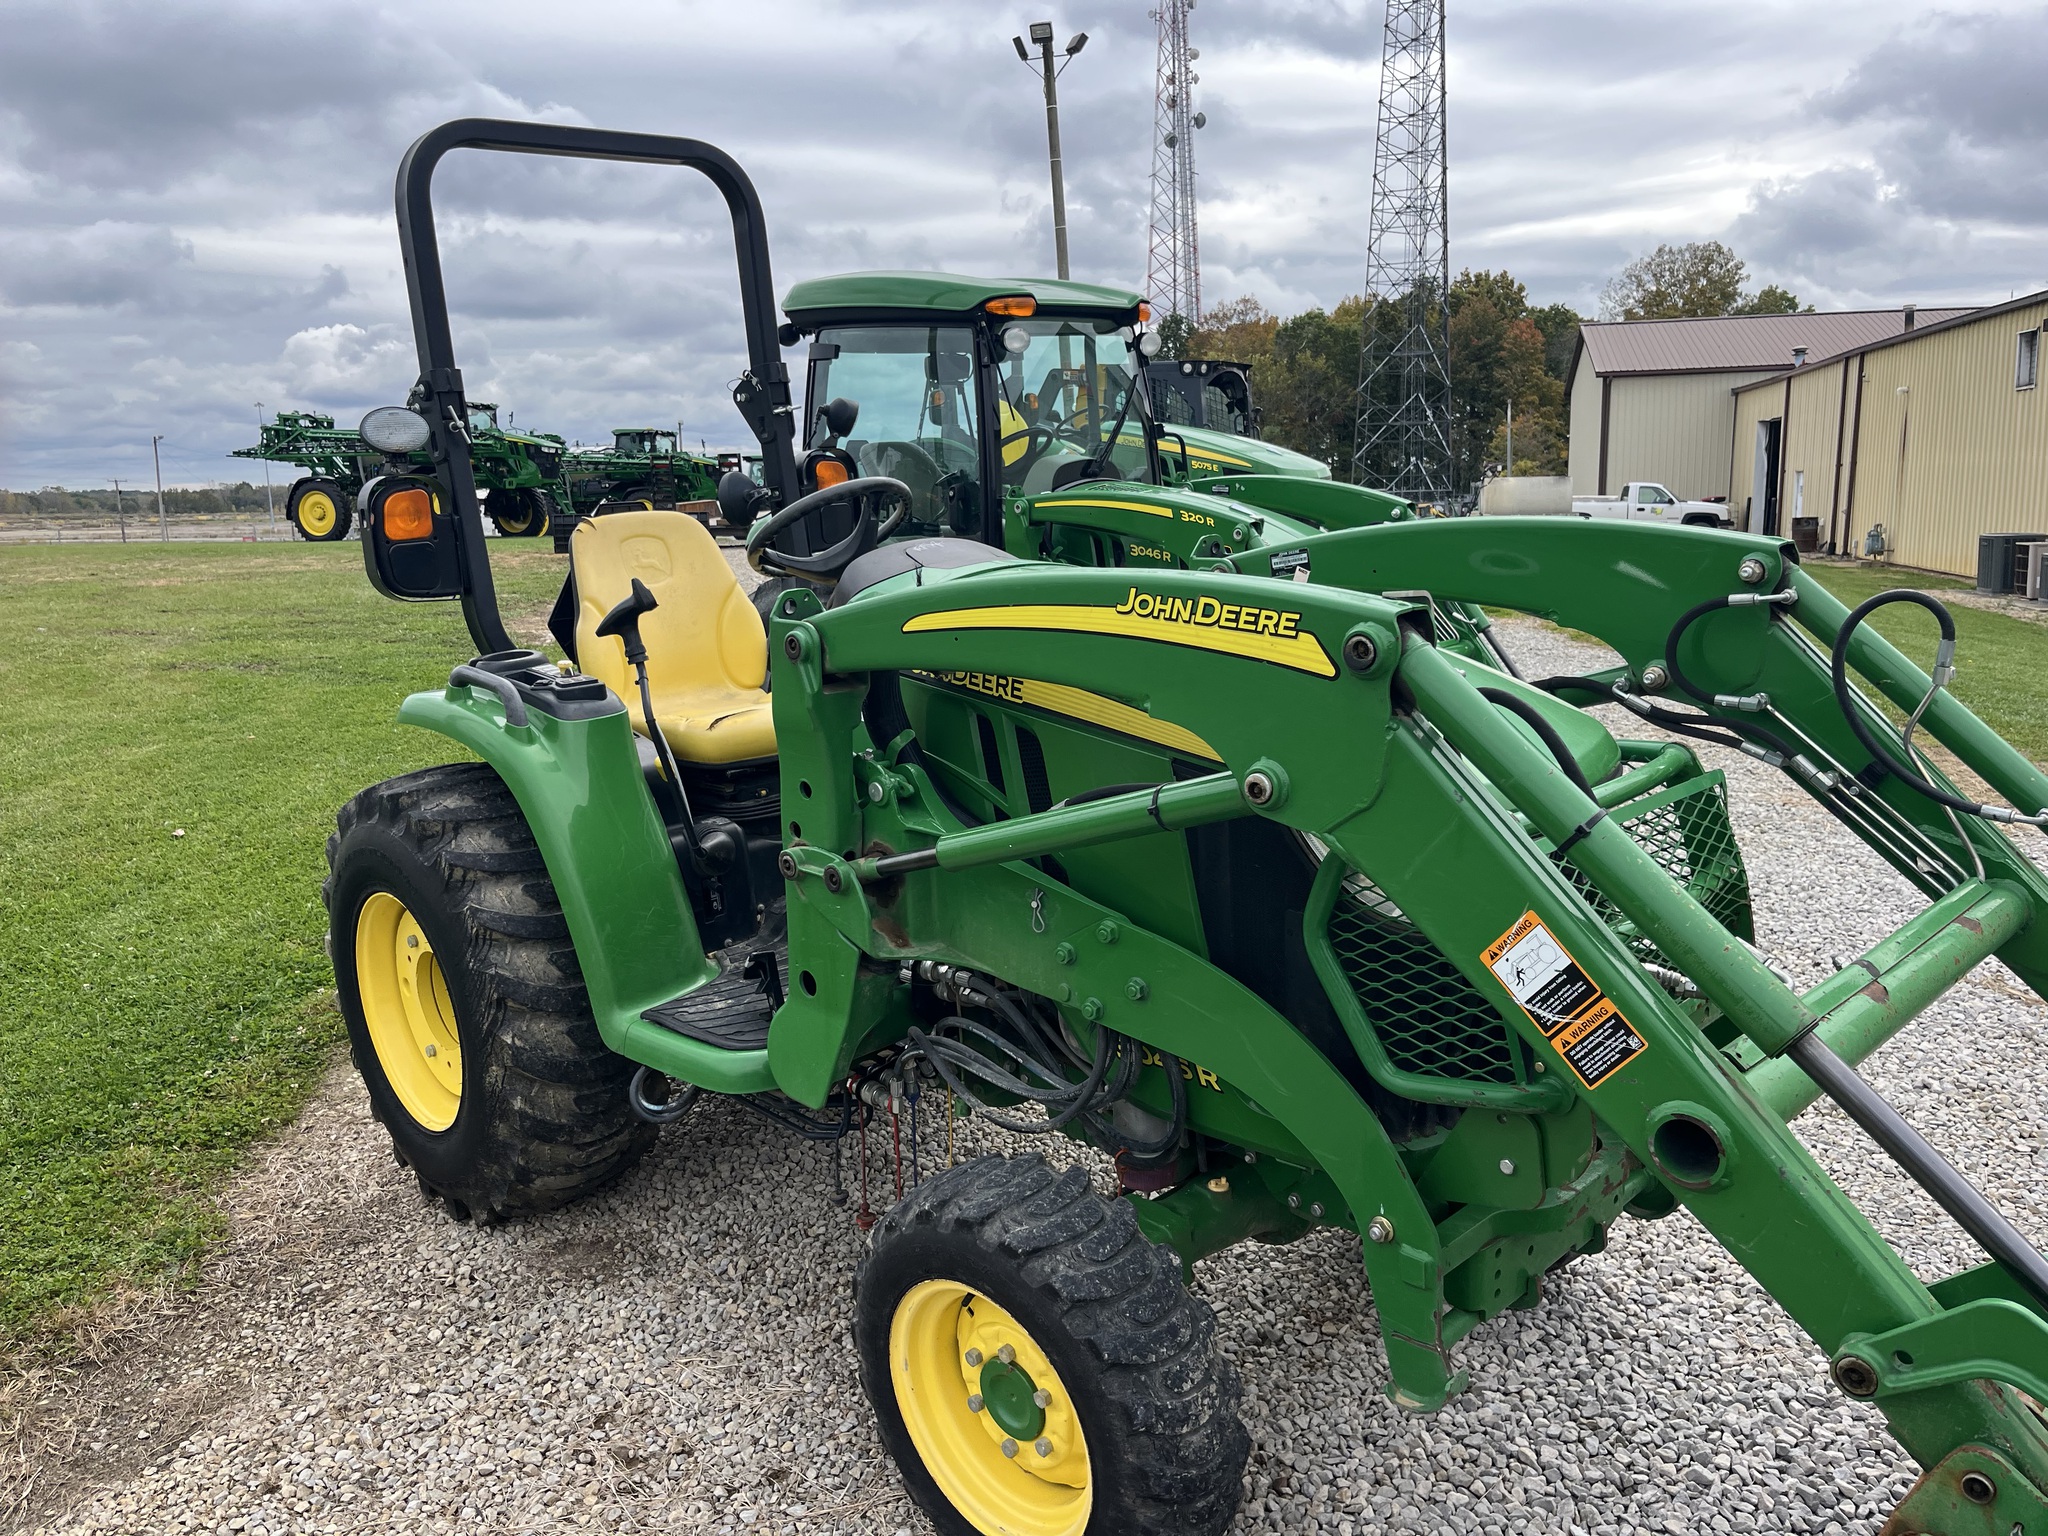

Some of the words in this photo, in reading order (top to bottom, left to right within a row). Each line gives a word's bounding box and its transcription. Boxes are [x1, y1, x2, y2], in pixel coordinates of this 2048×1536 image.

[1121, 437, 1137, 447] JOHN
[1191, 460, 1212, 469] 5075
[1212, 464, 1219, 472] E
[1179, 510, 1205, 524] 320
[1206, 517, 1215, 527] R
[1129, 544, 1161, 560] 3046
[1162, 551, 1171, 562] R
[1115, 587, 1194, 625] JOHN
[1194, 595, 1301, 639] DEERE
[951, 671, 1024, 704] DEERE
[1495, 919, 1532, 952] WARNING
[1539, 988, 1549, 997] injury
[1569, 1006, 1608, 1039] WARNING
[1195, 1063, 1224, 1094] R
